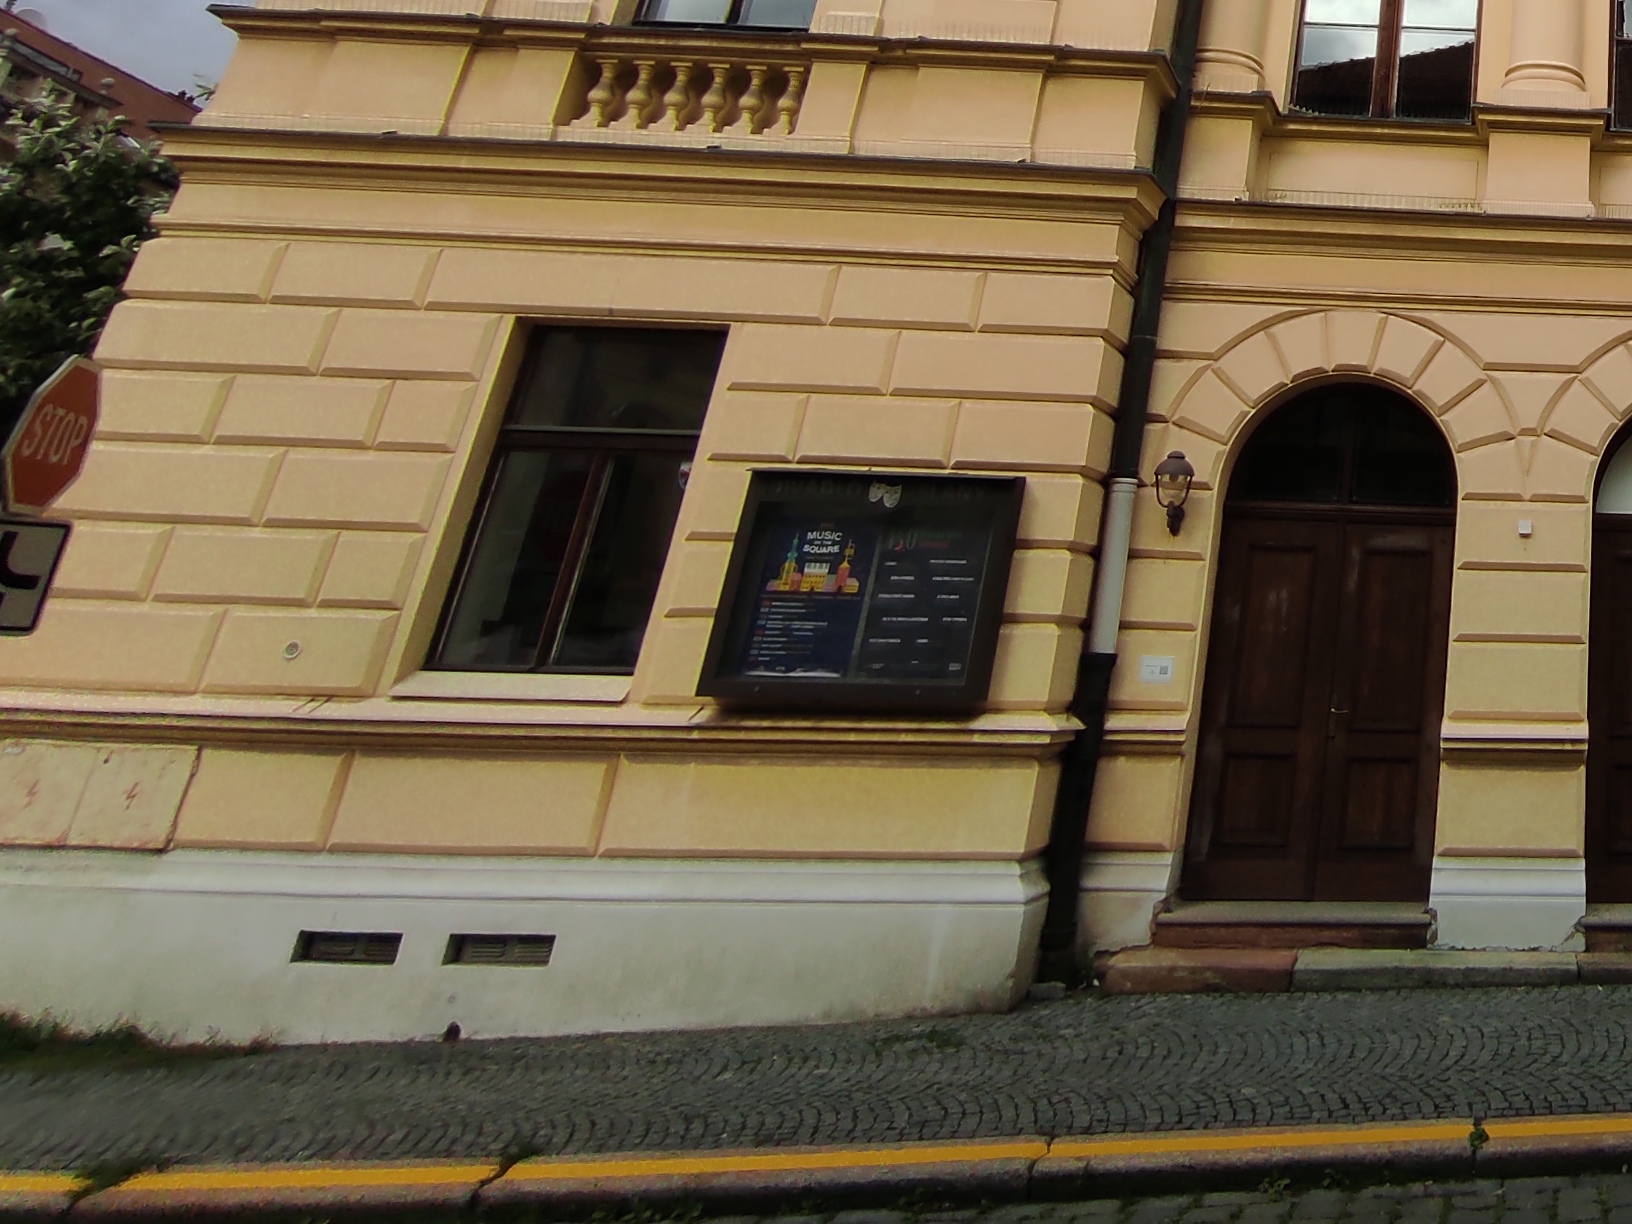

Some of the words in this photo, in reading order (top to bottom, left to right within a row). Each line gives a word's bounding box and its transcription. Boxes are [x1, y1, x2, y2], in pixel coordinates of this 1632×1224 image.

[21, 404, 88, 465] STOP
[806, 530, 843, 541] MUSIC
[803, 544, 840, 554] SQUARE
